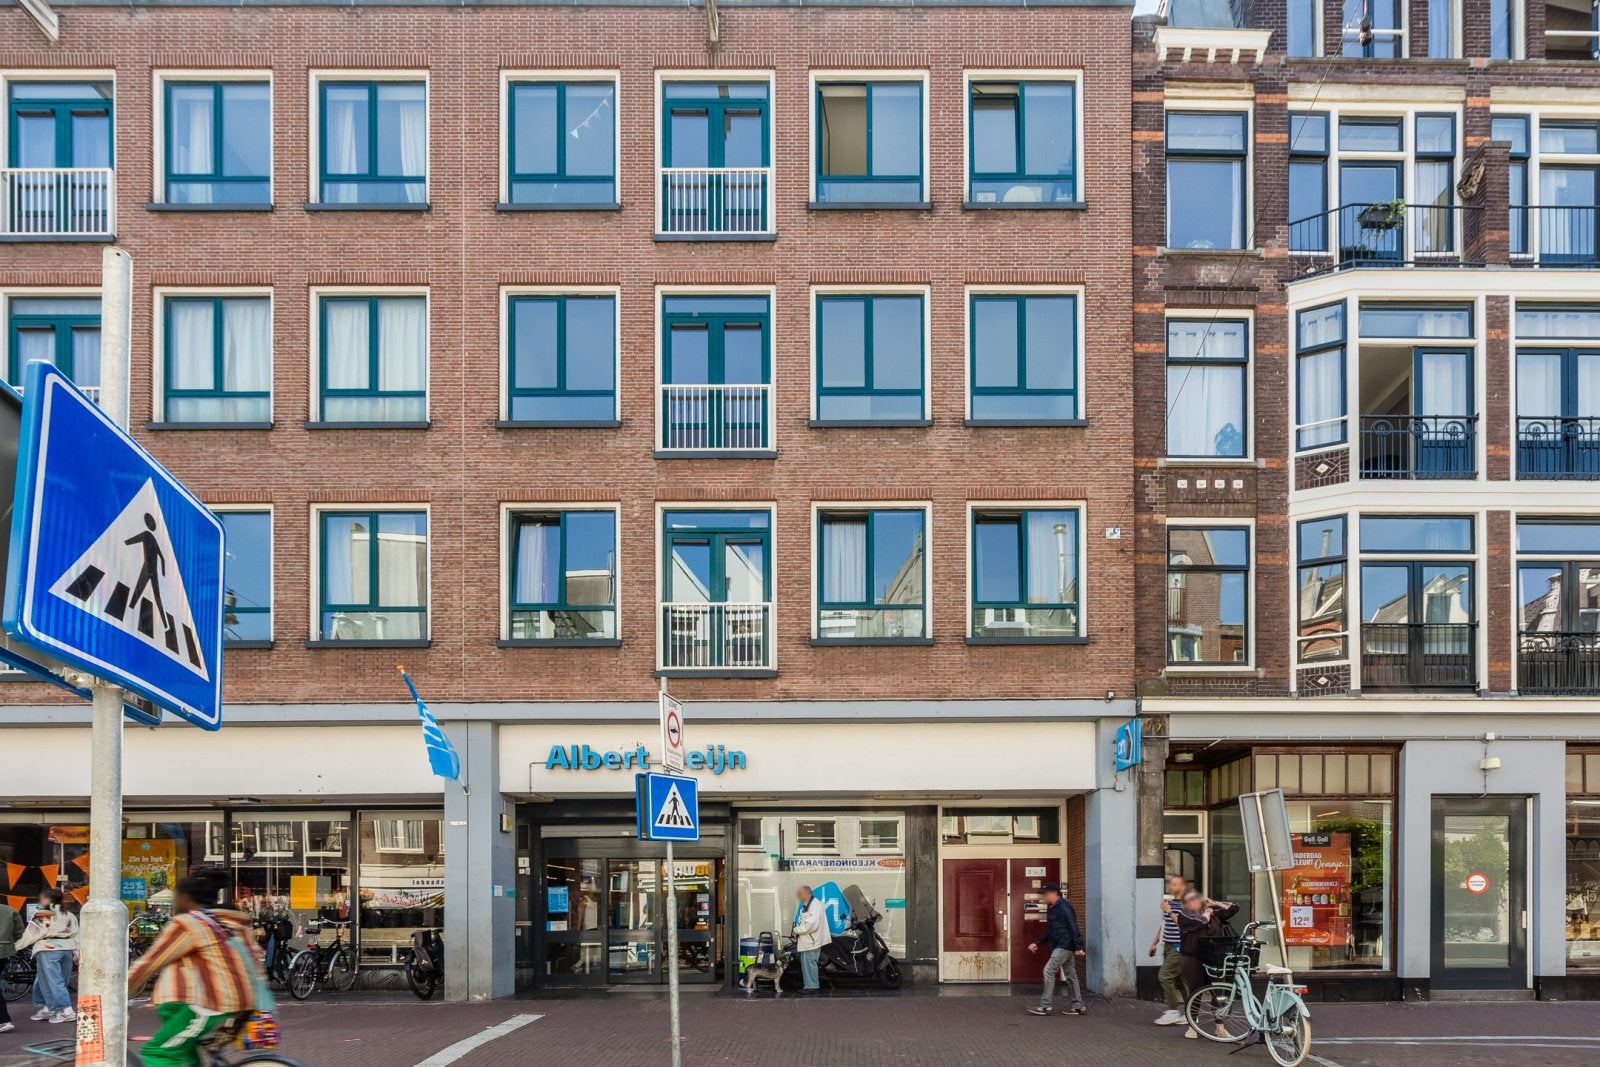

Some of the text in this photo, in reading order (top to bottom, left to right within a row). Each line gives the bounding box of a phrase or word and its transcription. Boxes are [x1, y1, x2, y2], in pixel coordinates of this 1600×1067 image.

[545, 743, 650, 770] Albert
[686, 744, 747, 775] eijn
[128, 855, 140, 863] Zin
[141, 855, 149, 863] in
[123, 881, 144, 890] 25%
